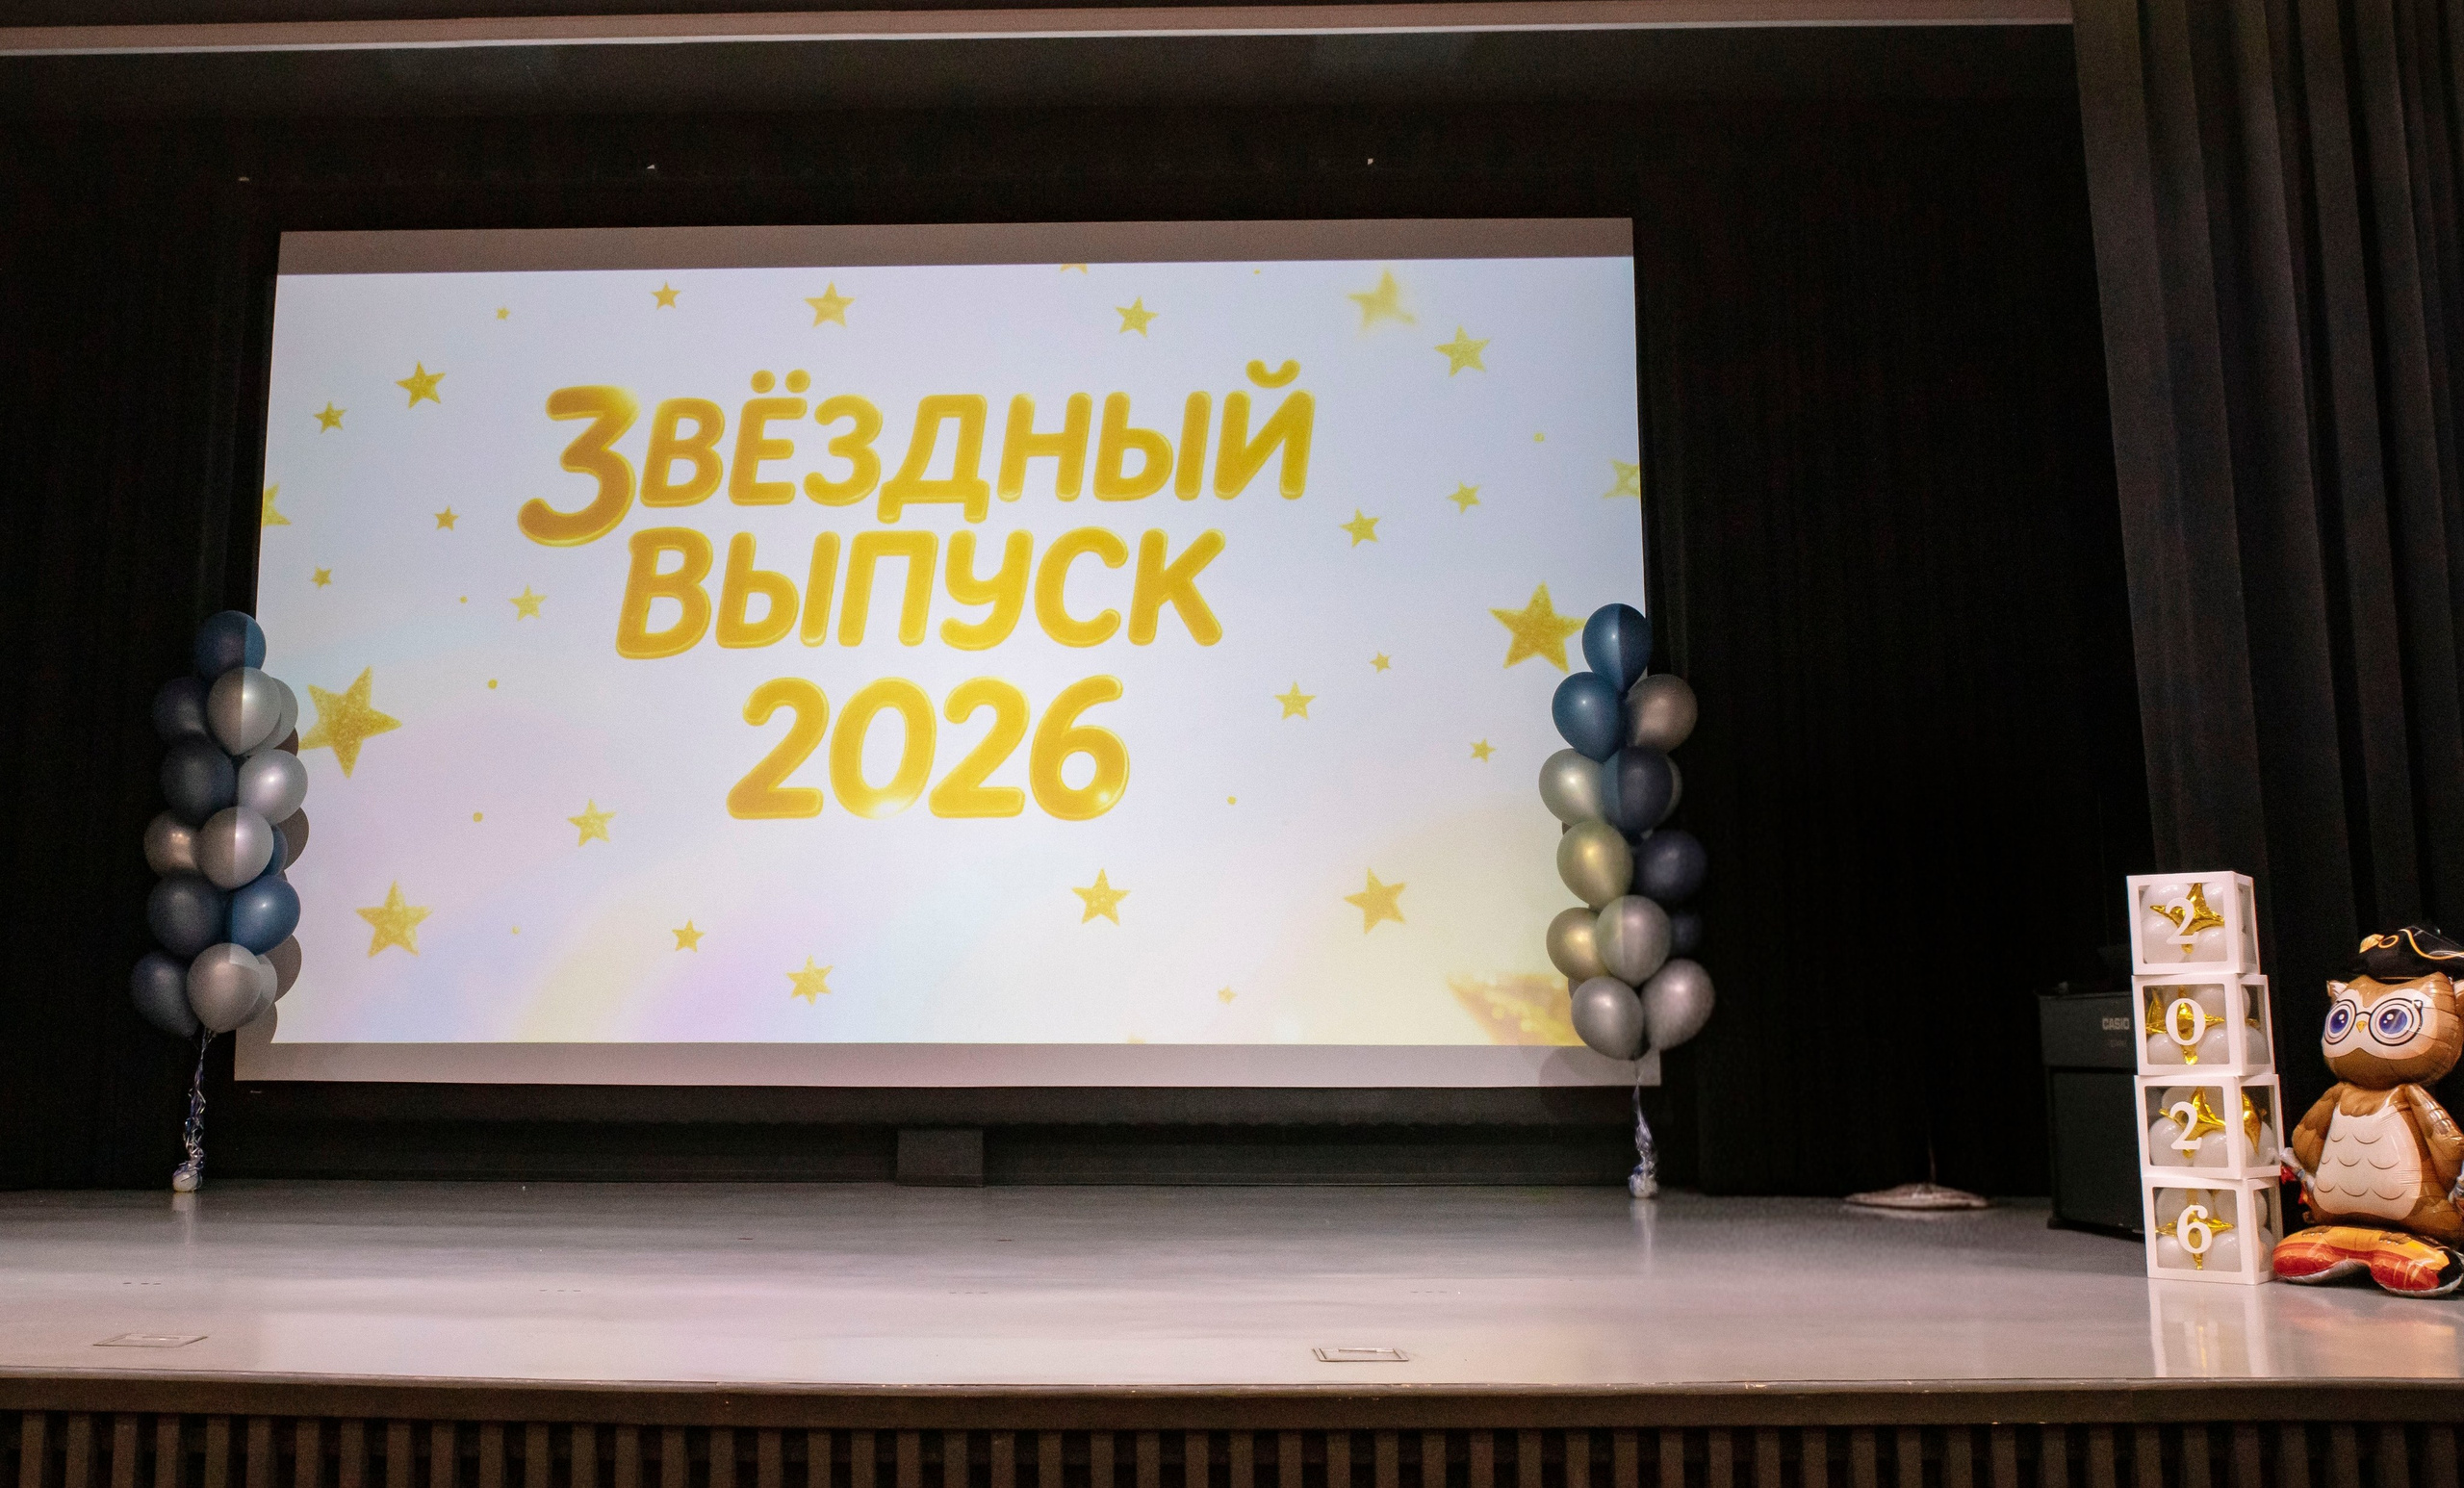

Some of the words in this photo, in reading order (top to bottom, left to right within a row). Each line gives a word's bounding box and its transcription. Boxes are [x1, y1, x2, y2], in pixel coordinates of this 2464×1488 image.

[517, 359, 1315, 547] ЗВЁЗДНЫЙ
[616, 526, 1226, 660] ВЫПУСК
[727, 674, 1130, 822] 2026
[2101, 1016, 2131, 1031] CASIO
